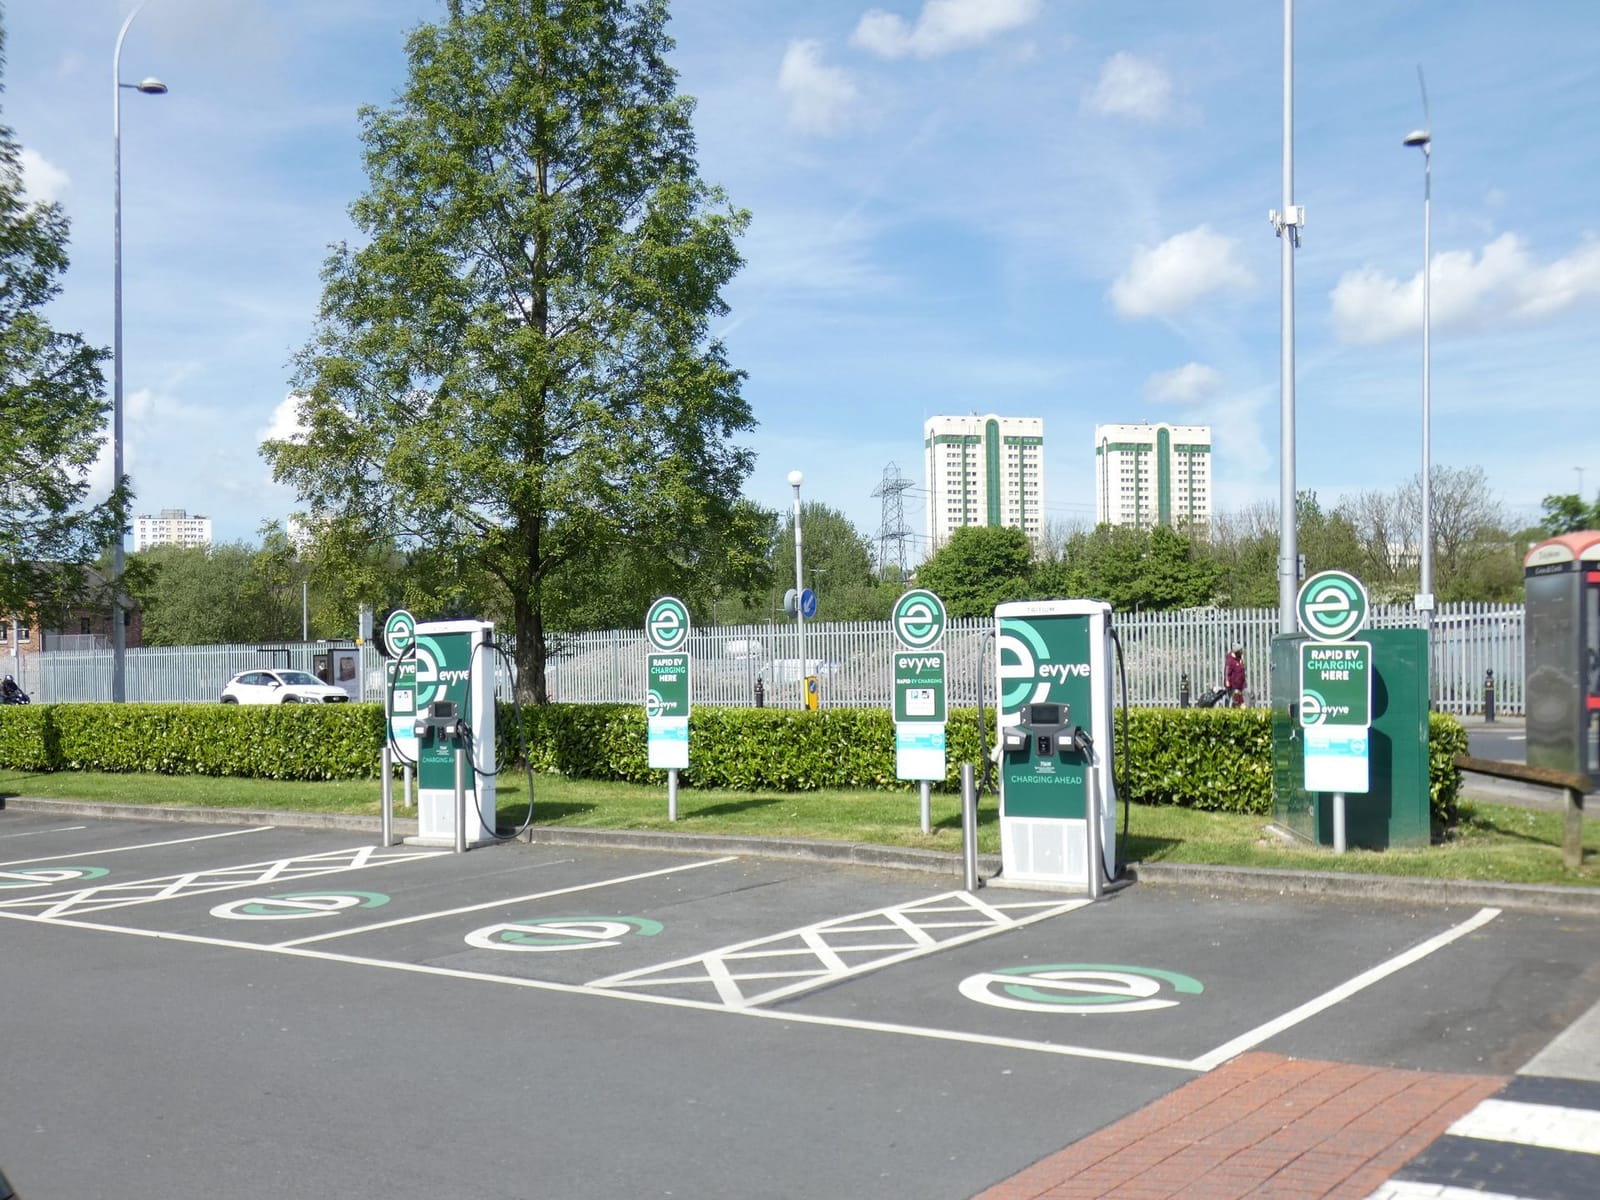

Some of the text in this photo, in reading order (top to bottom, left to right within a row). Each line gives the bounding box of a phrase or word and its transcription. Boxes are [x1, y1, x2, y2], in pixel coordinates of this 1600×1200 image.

[1311, 649, 1360, 660] RAPID EV
[653, 658, 683, 666] RAPID EV
[899, 657, 941, 675] evyve
[1307, 660, 1364, 670] CHARGING
[388, 664, 415, 679] eyve
[651, 666, 686, 674] CHARGING
[1038, 663, 1091, 685] evyve
[1321, 670, 1350, 681] HERE
[659, 674, 677, 682] HERE
[1321, 705, 1350, 718] evyve
[1011, 775, 1082, 785] CHARGING AHEAD
